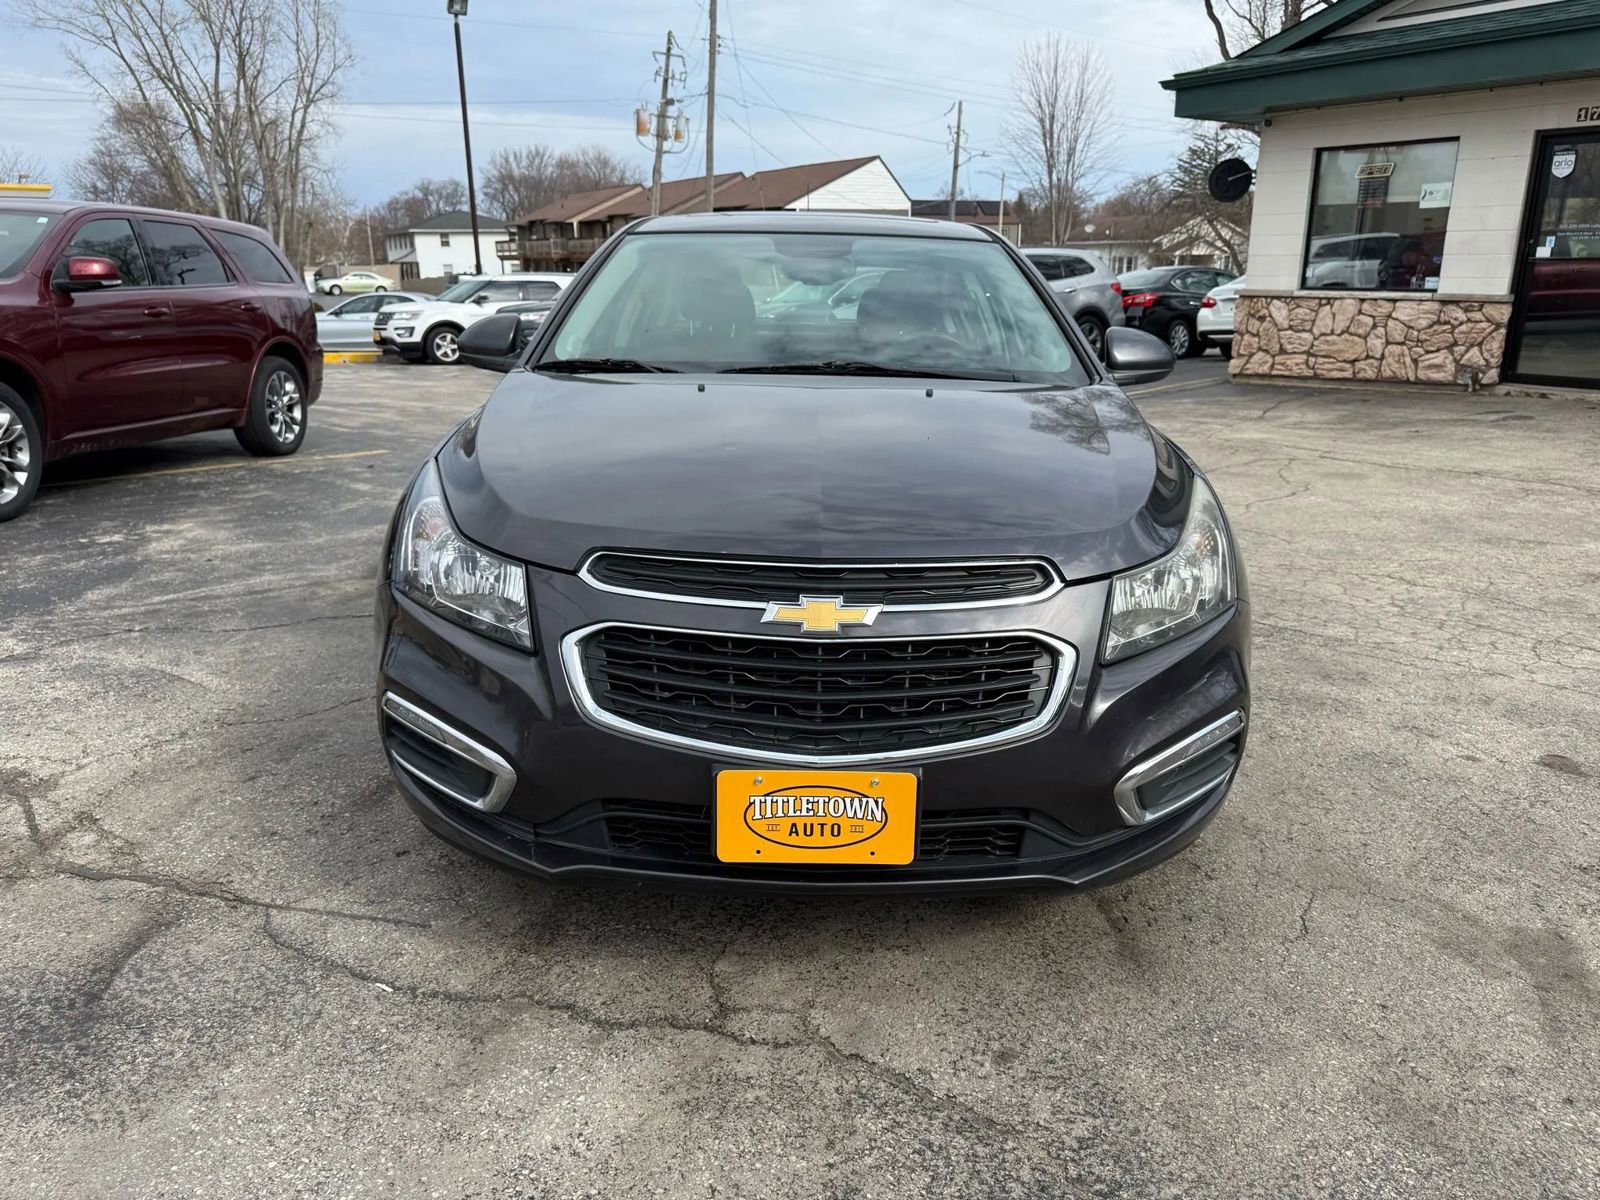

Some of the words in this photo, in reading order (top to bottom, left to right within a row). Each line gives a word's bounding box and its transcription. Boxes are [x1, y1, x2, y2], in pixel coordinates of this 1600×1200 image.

[1553, 157, 1574, 167] arlo
[749, 795, 884, 823] TITLETOWN
[788, 822, 841, 837] AUTO
